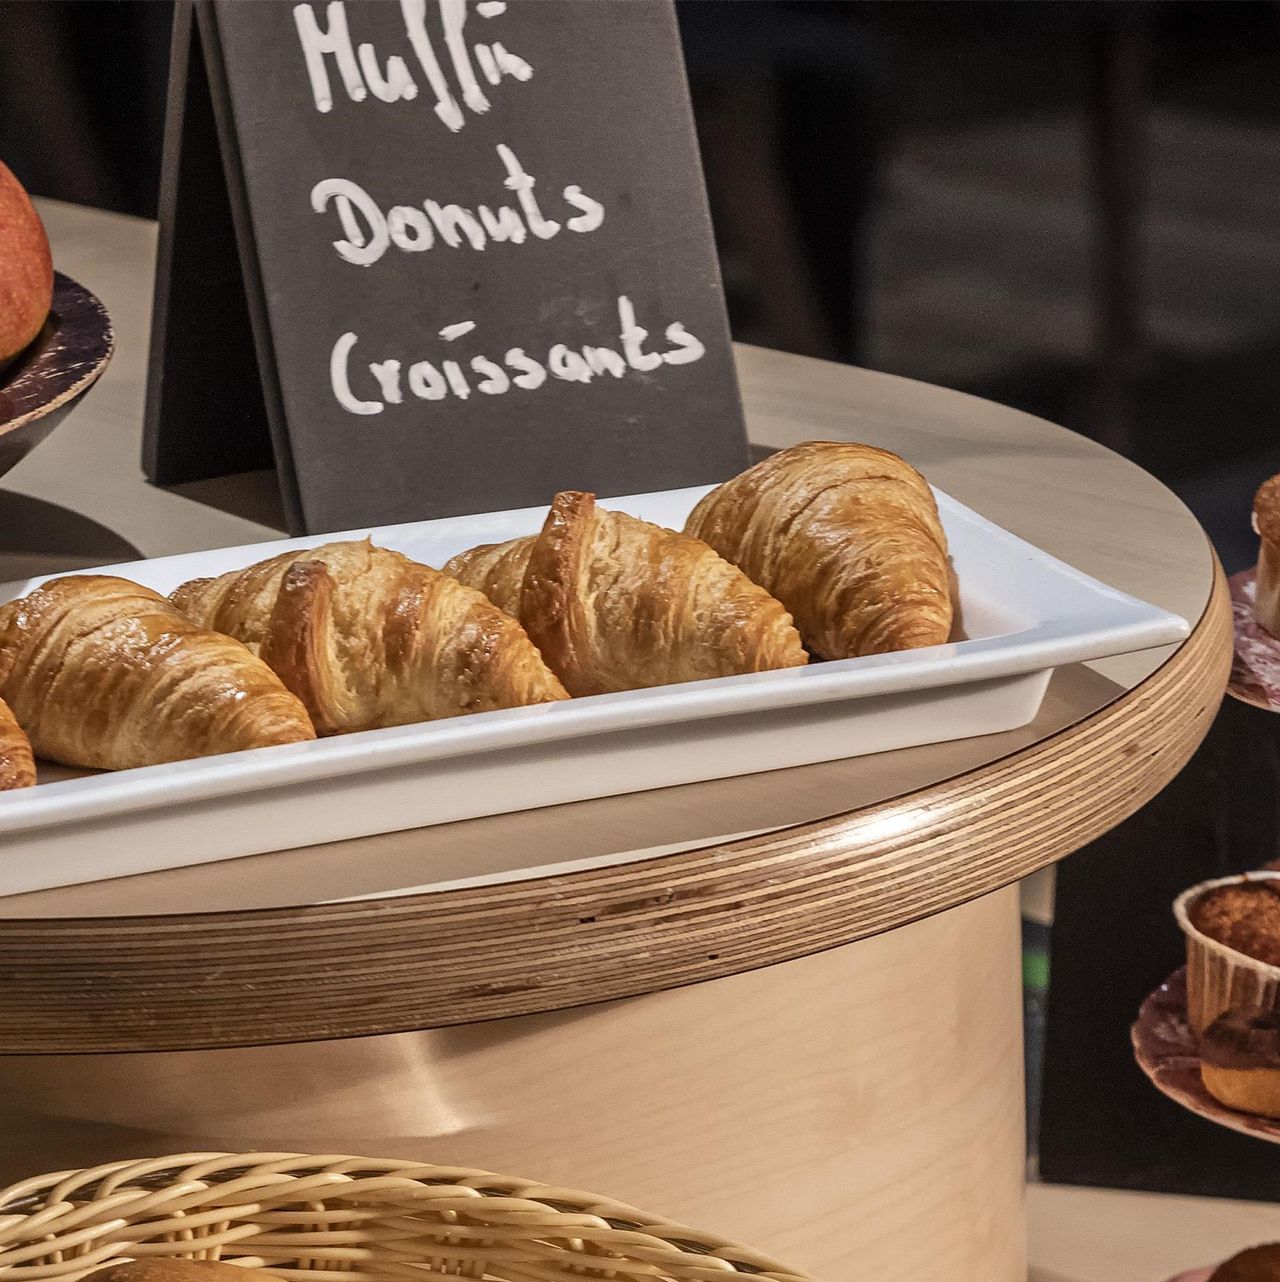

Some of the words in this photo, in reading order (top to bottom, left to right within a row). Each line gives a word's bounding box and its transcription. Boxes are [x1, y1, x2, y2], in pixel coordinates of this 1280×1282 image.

[293, 0, 534, 132] Muffin
[311, 144, 605, 267] Donuts
[331, 296, 705, 415] Croissants
